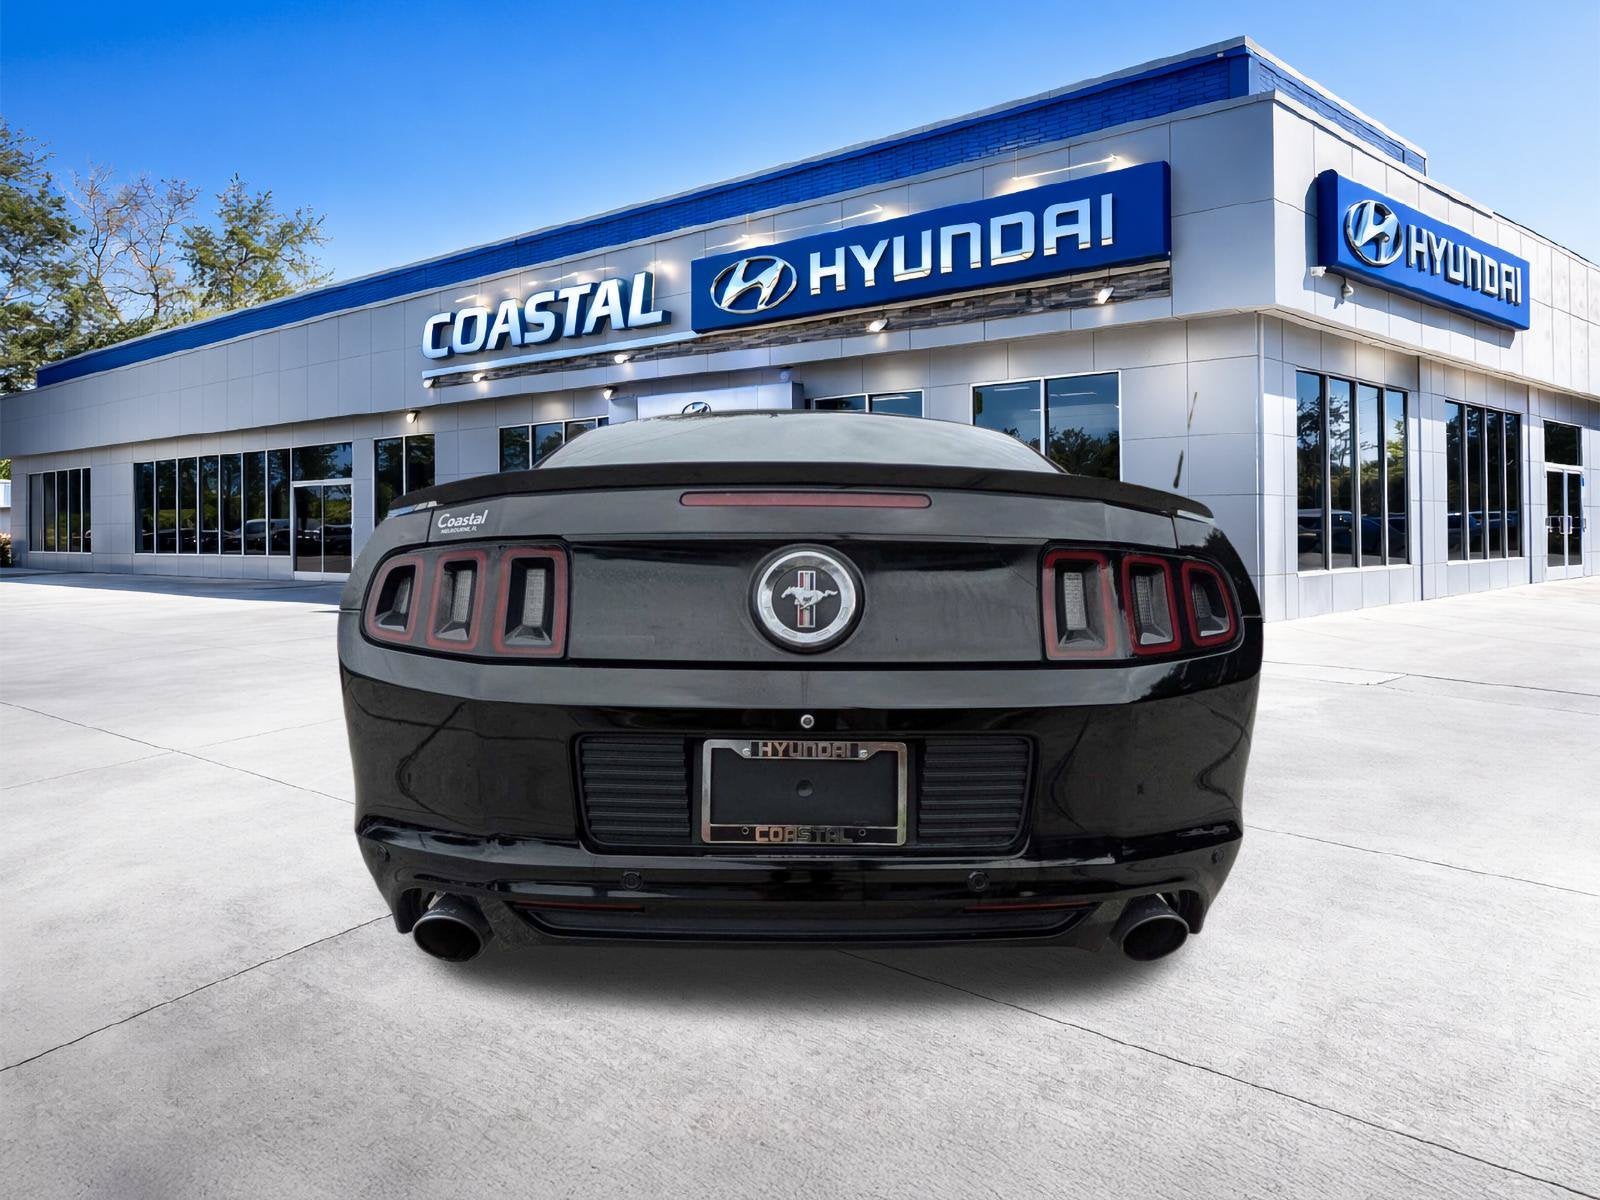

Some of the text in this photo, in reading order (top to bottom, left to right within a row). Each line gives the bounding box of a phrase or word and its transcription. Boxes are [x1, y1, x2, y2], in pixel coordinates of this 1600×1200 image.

[809, 192, 1113, 296] HYUNDAI
[1406, 224, 1522, 307] HYUNDAI
[421, 271, 669, 360] COASTAL
[437, 509, 489, 528] Coastal
[758, 742, 854, 758] HYUNDAI
[754, 826, 854, 843] COASTAL
